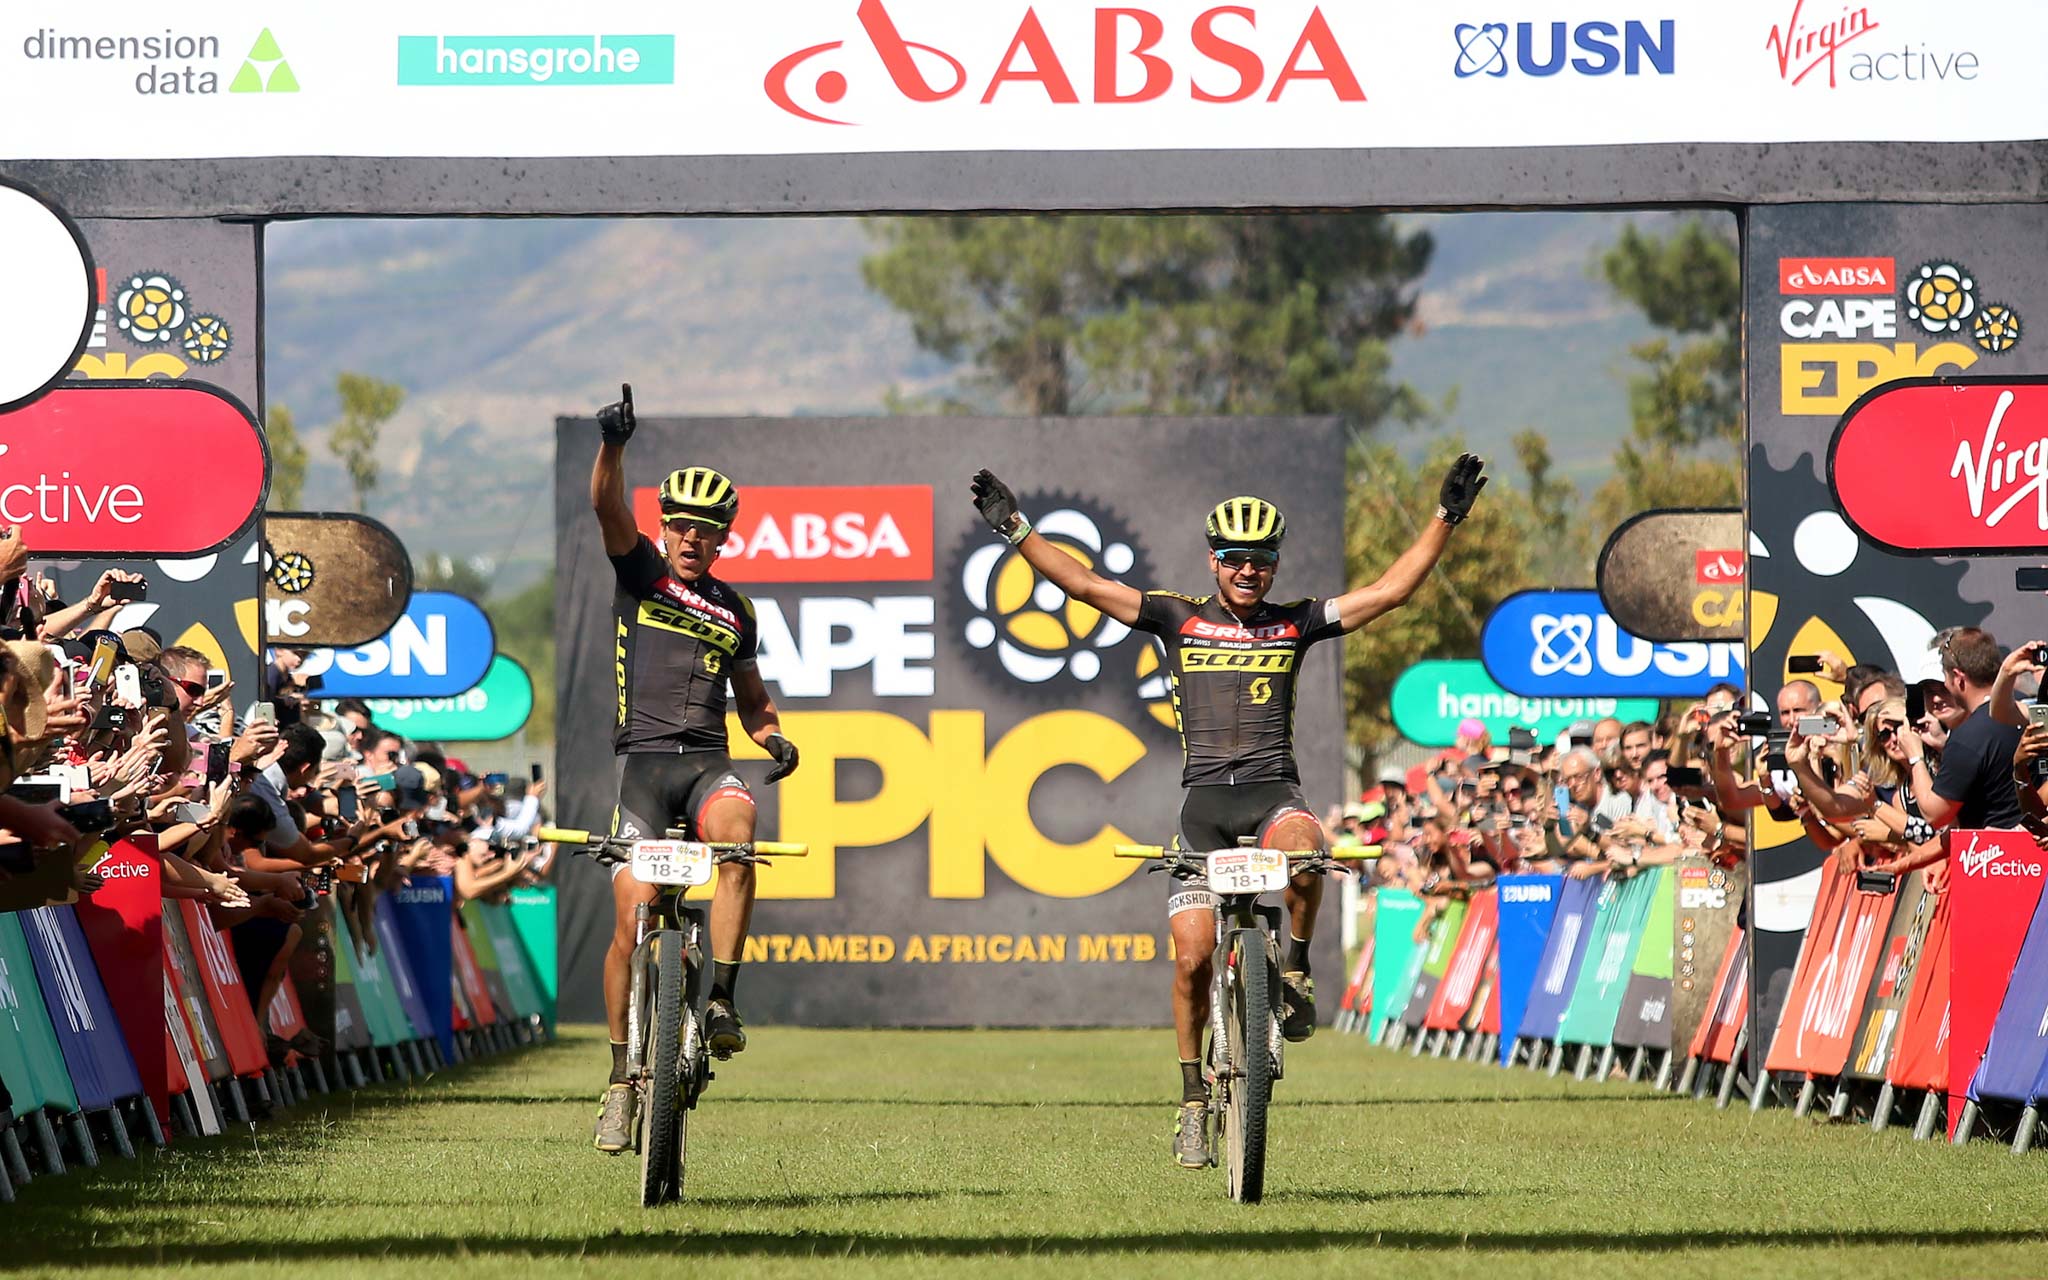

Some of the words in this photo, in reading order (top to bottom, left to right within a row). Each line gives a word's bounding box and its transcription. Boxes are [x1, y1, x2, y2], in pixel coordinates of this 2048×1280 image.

[23, 28, 219, 59] dimension
[436, 35, 640, 82] hansgrohe
[980, 5, 1367, 103] ABSA
[1517, 20, 1675, 77] USN
[1766, 0, 1879, 88] Virgin
[1849, 43, 1979, 81] active
[134, 65, 219, 94] data
[1824, 266, 1887, 285] ABSA
[1780, 300, 1896, 338] CAPE
[1950, 391, 2048, 531] Virg
[0, 472, 144, 523] ctive
[747, 512, 911, 560] ABSA
[646, 608, 738, 651] SCOTT
[727, 597, 935, 697] APE
[1185, 653, 1293, 667] SCOTT
[685, 709, 1147, 900] PIC
[101, 861, 149, 878] active
[651, 863, 693, 878] 18-2
[1214, 864, 1248, 875] CAPE
[1959, 835, 2004, 878] Virgin
[1990, 860, 2041, 876] active
[1231, 874, 1267, 888] 18-1
[1681, 888, 1726, 909] EPIC
[744, 935, 895, 963] NTAMED
[904, 935, 1067, 963] AFRICAN
[1079, 934, 1156, 962] MTB
